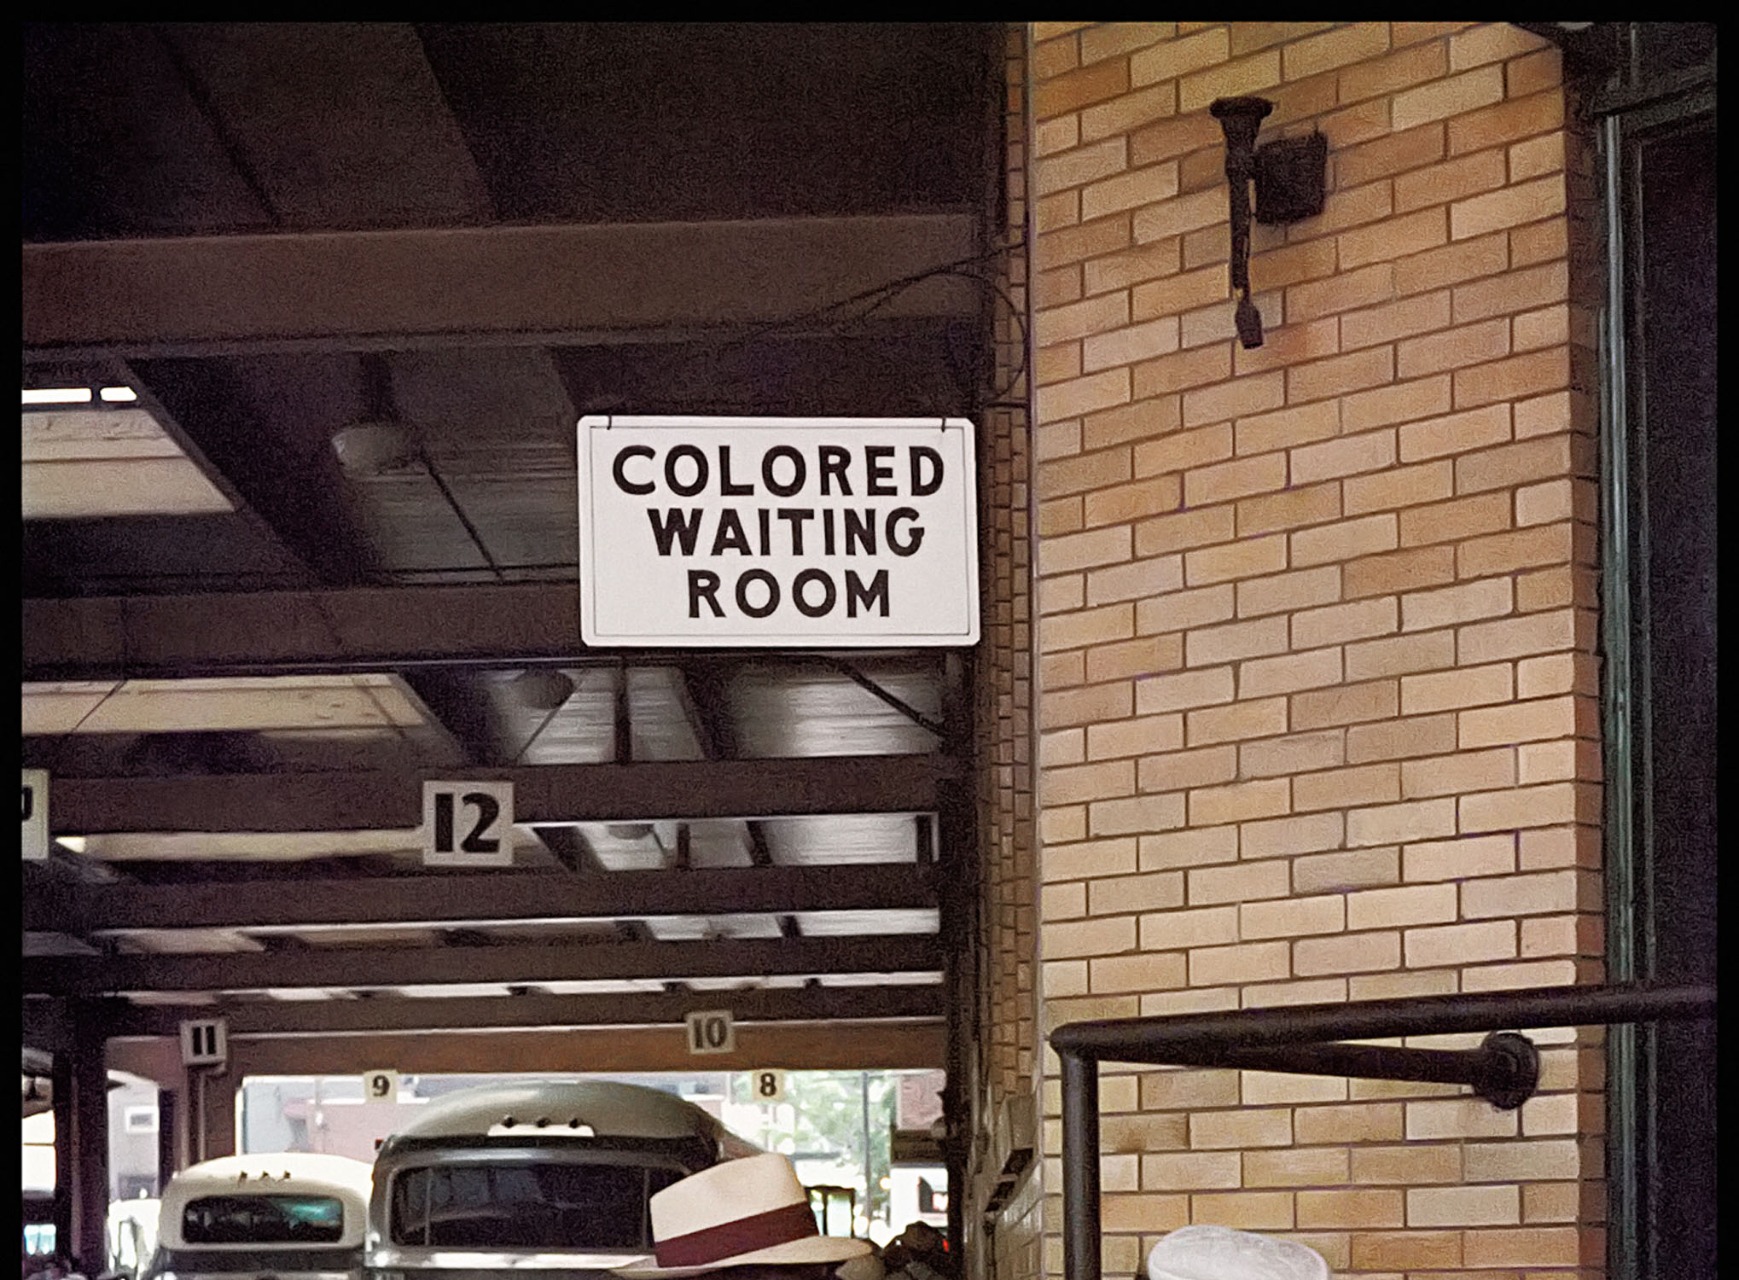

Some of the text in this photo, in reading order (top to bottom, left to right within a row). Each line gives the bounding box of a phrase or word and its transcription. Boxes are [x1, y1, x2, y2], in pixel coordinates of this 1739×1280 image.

[612, 444, 944, 497] COLORED
[647, 507, 925, 556] WAITING
[687, 568, 891, 618] ROOM
[435, 792, 500, 853] 12
[192, 1026, 216, 1056] 11
[693, 1018, 727, 1049] 10
[372, 1075, 390, 1097] 9
[760, 1073, 777, 1097] 8
